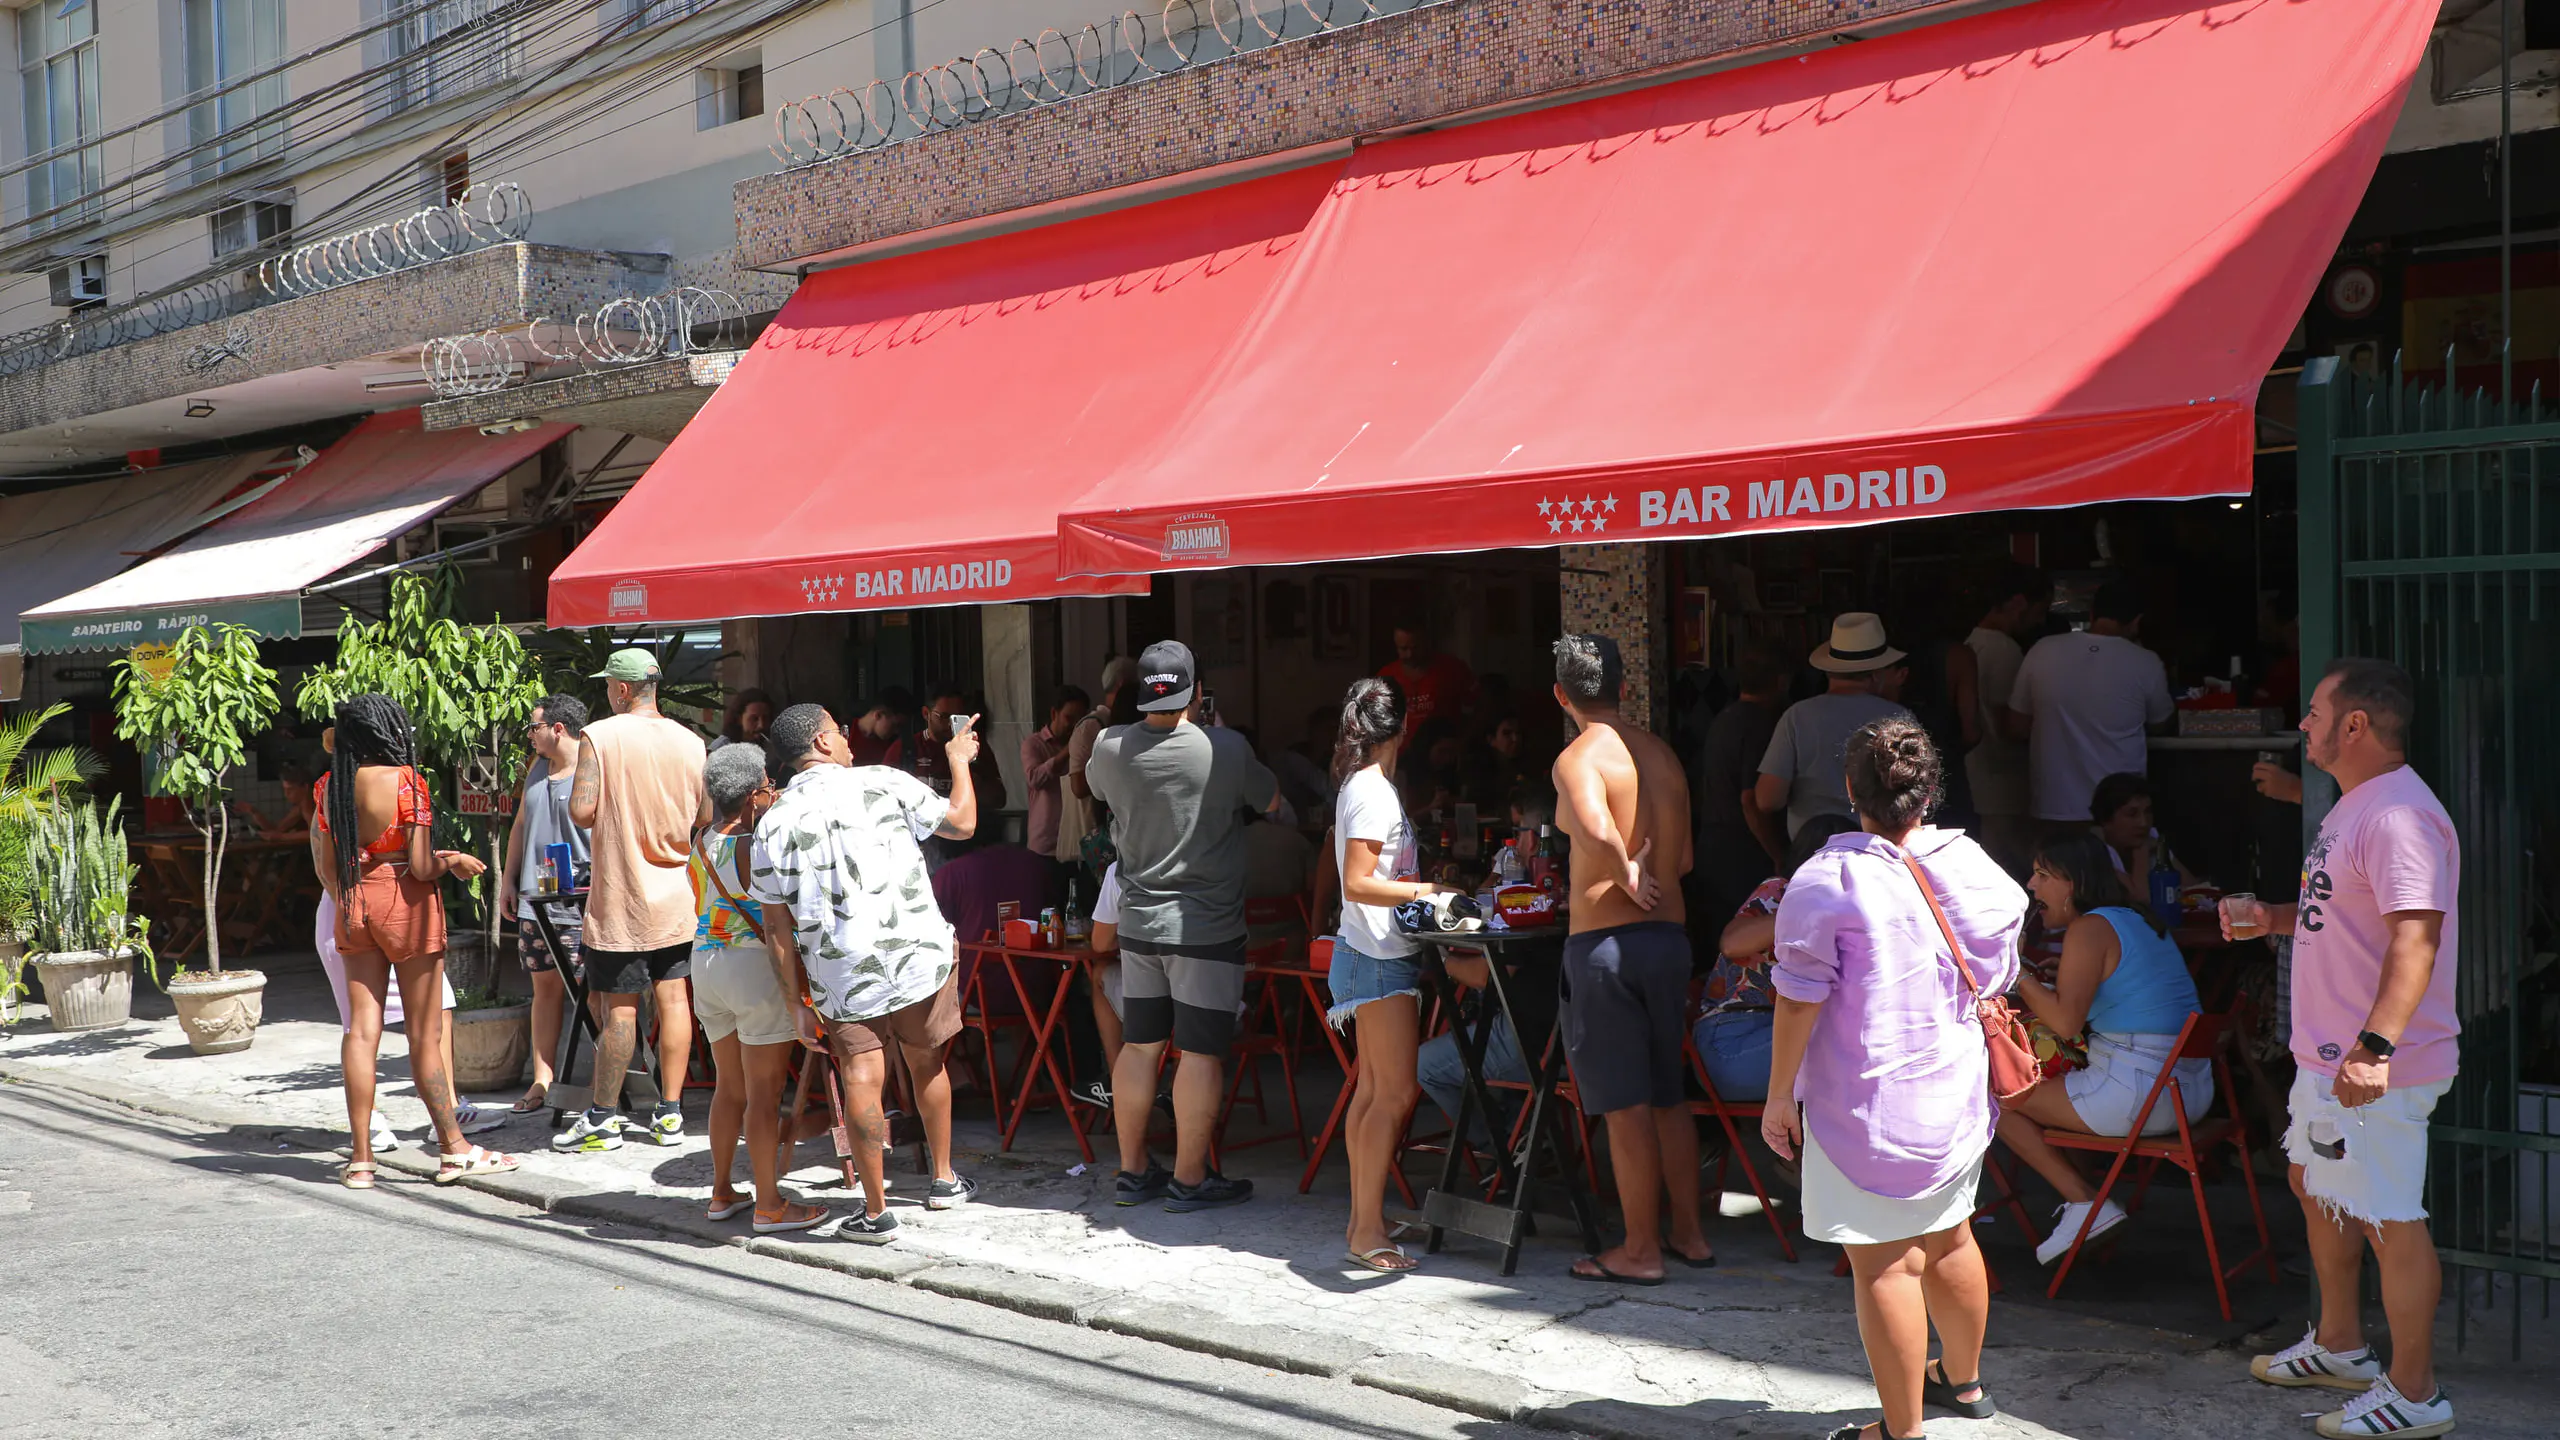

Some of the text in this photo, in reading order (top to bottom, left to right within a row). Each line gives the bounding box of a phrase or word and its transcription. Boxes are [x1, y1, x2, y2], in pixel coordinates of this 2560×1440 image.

[1639, 464, 1947, 527] BAR MADRID
[1171, 526, 1222, 550] BRAHMA
[855, 559, 1012, 599] BAR MADRID
[613, 589, 643, 608] BRAHMA
[71, 613, 209, 637] SAPATEIRO RÁPIDO
